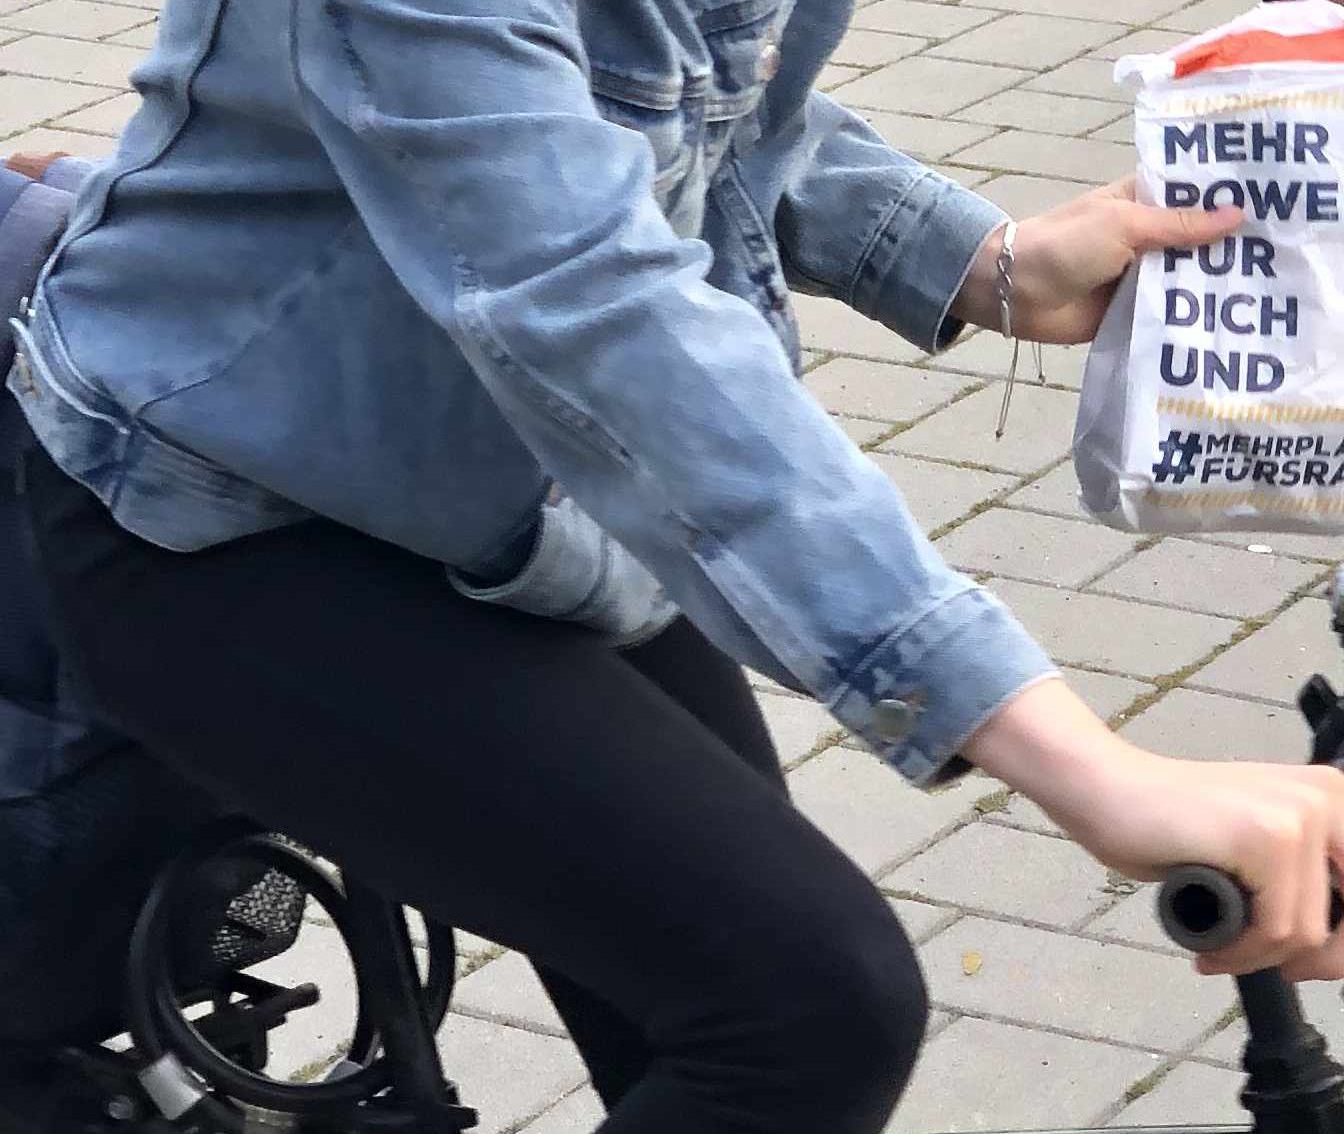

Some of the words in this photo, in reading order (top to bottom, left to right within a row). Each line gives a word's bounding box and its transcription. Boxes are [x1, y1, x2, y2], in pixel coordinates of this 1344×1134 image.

[1164, 122, 1330, 165] MEHR
[1164, 287, 1299, 337] DICH
[1160, 342, 1286, 393] UND
